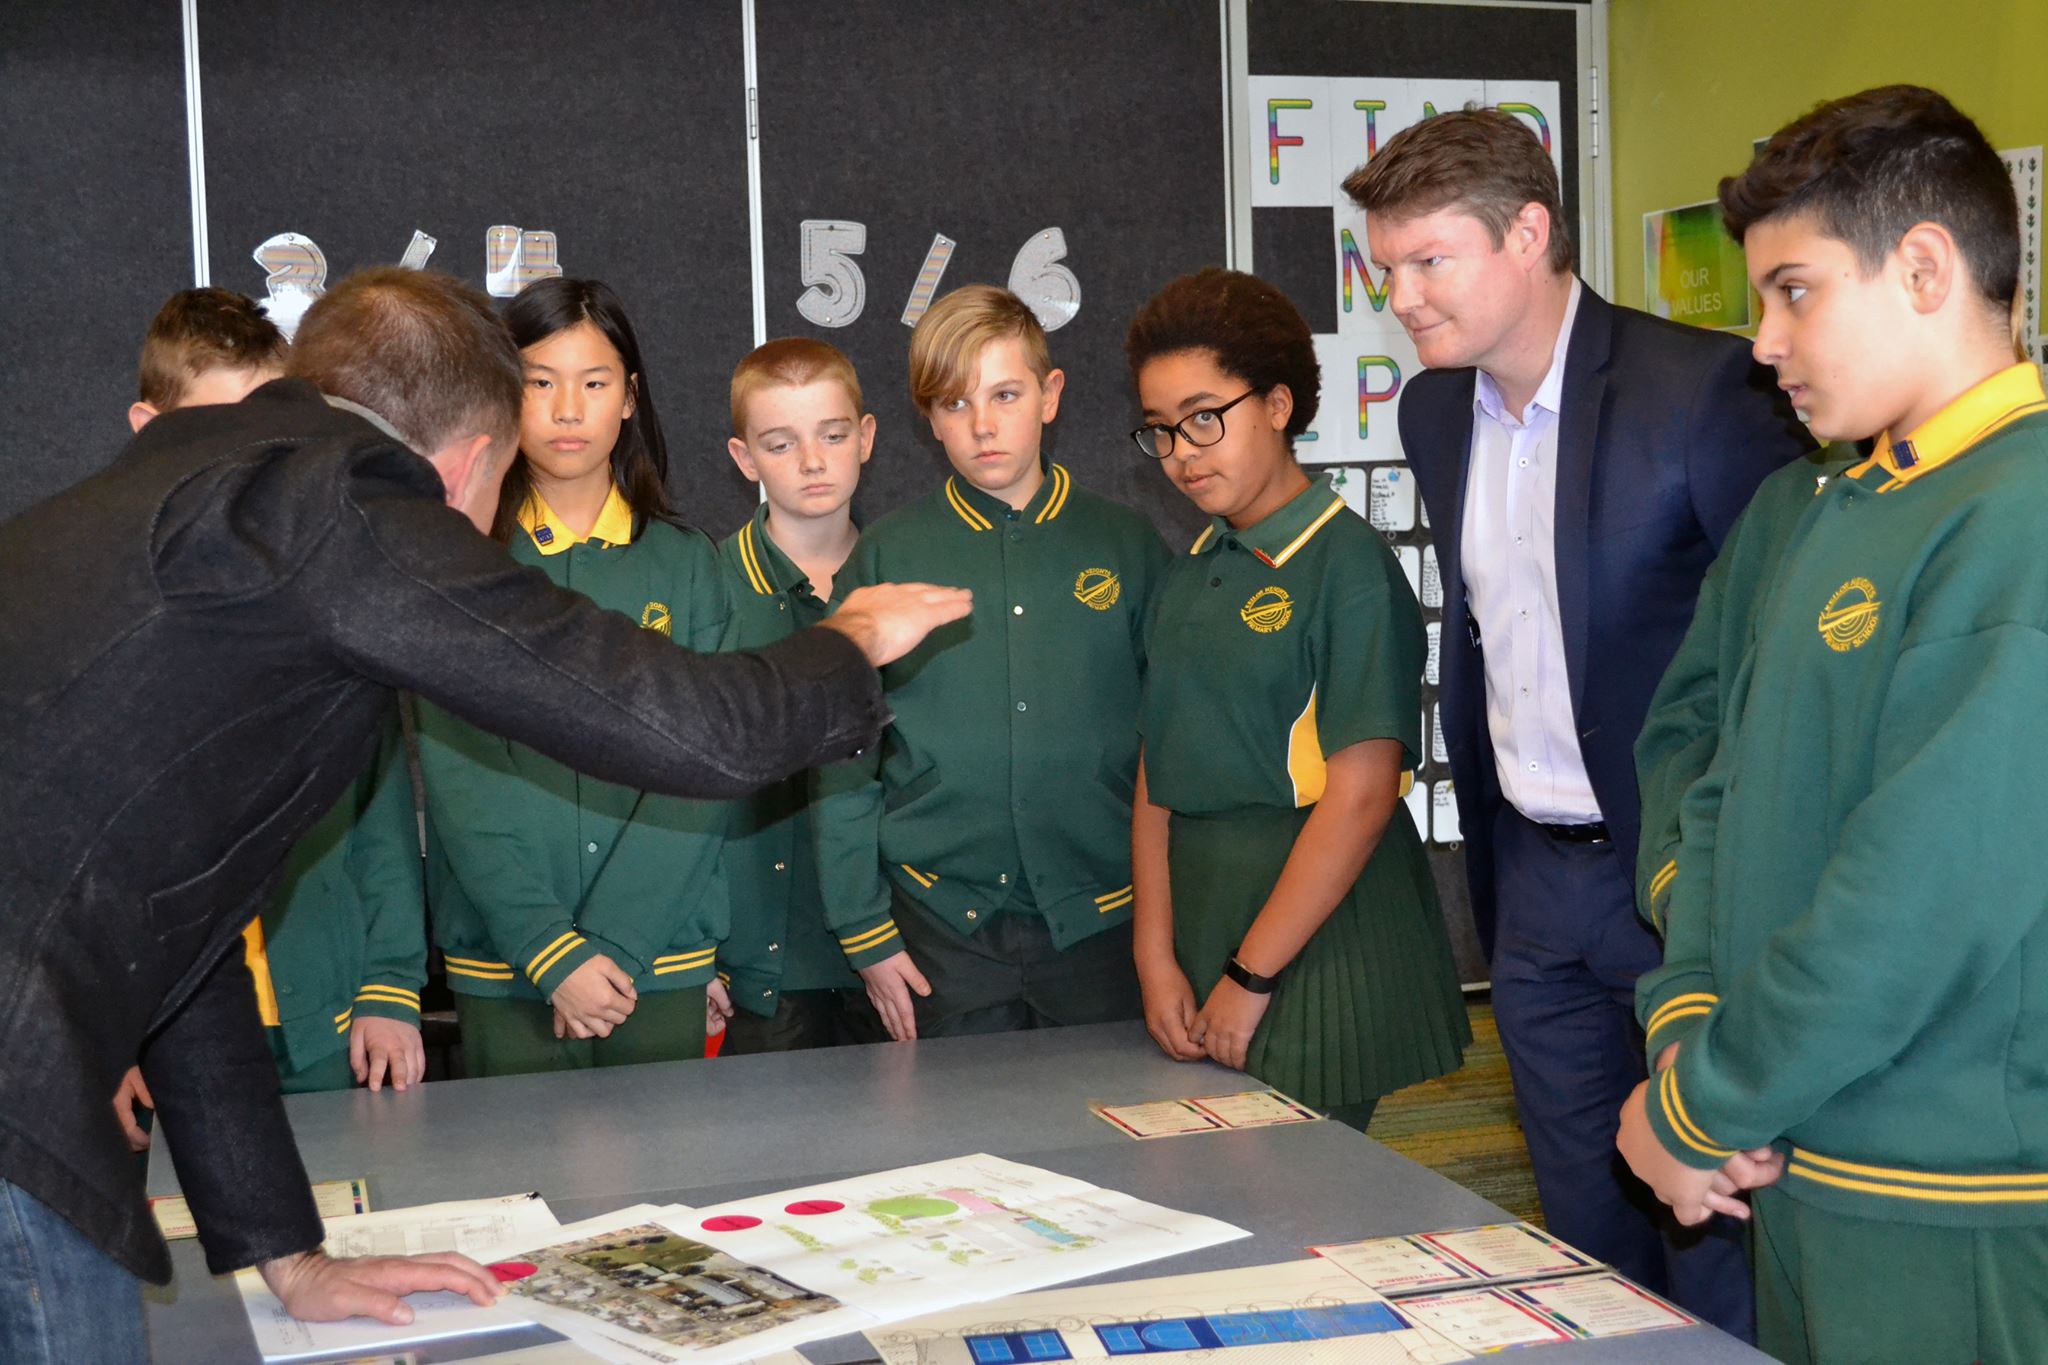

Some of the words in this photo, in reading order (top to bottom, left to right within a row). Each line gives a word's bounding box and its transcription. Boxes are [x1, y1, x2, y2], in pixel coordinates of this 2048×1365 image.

[1680, 267, 1709, 288] OUR
[1672, 293, 1722, 316] VALUES
[1852, 613, 1879, 648] SCHOOL
